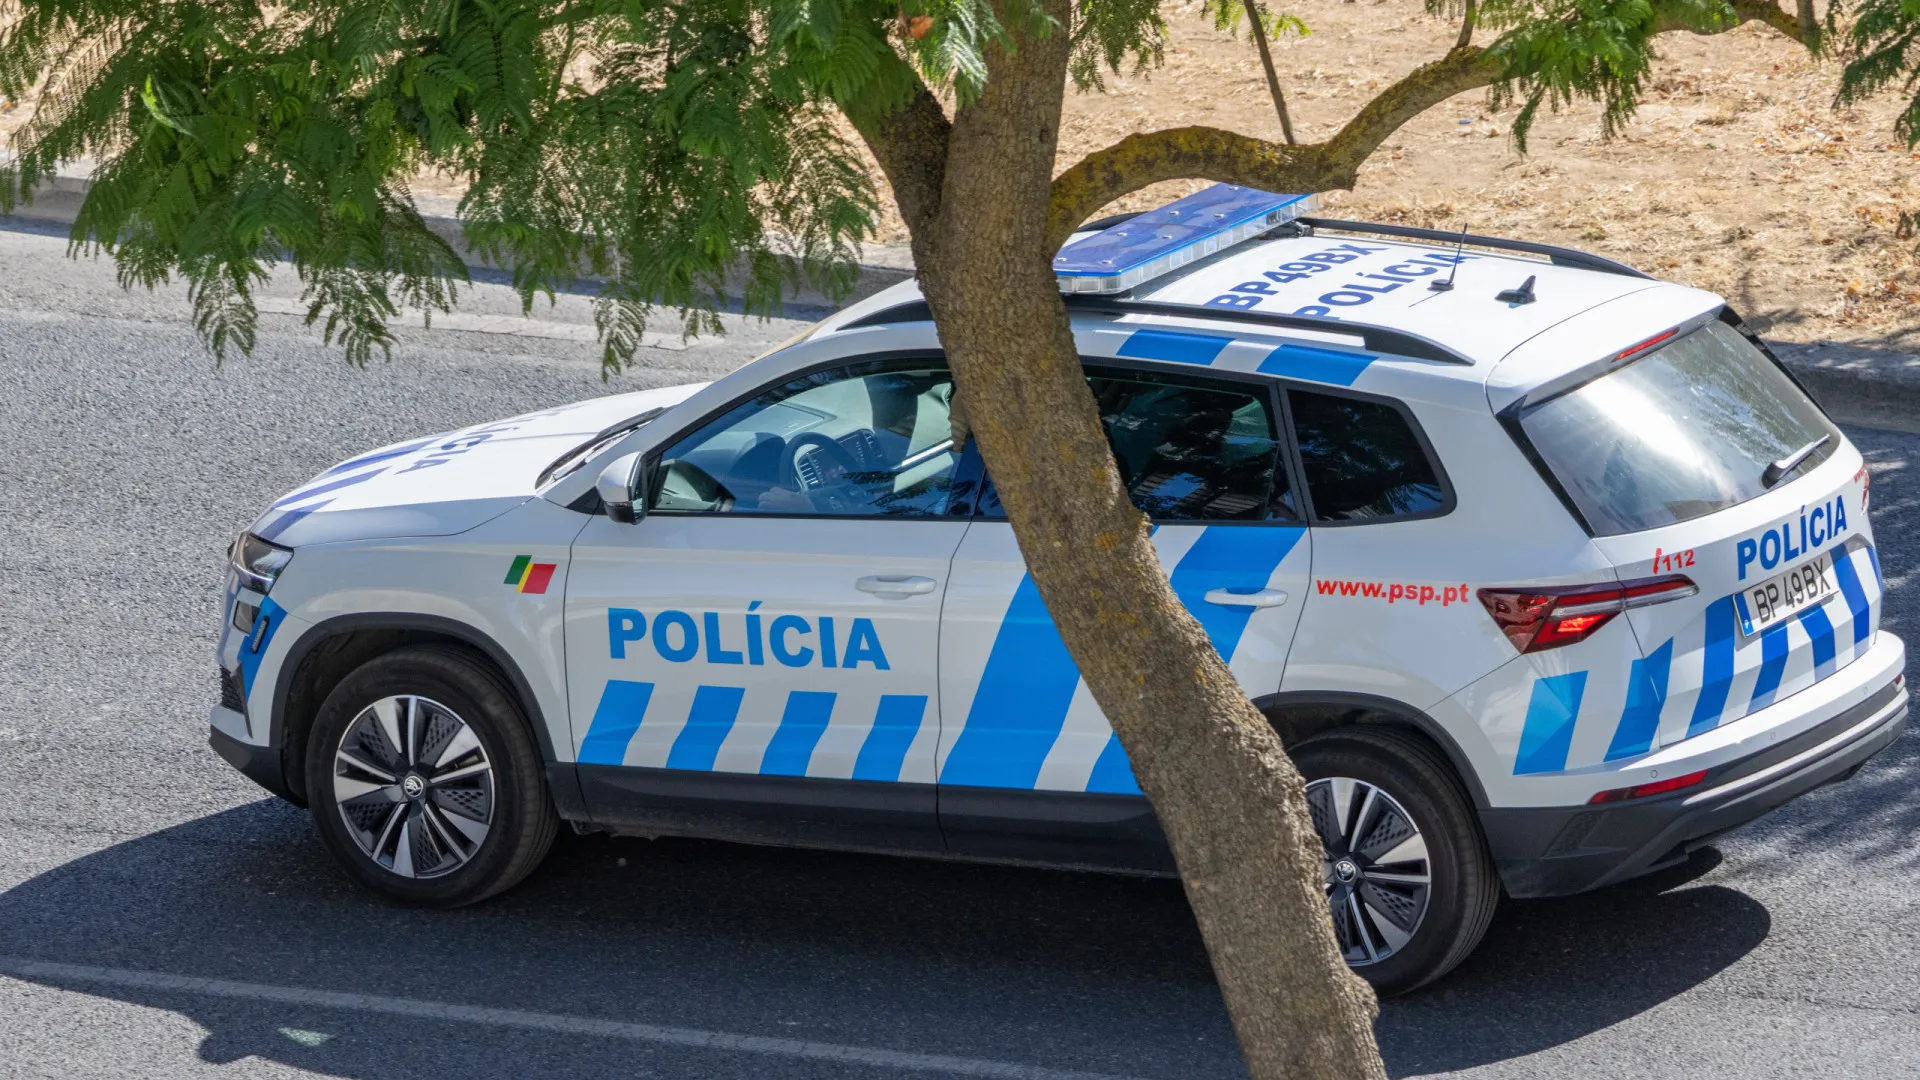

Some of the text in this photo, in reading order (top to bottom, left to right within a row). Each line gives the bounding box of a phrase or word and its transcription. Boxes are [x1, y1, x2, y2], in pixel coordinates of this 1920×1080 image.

[1202, 243, 1391, 311] BP49BX
[1292, 253, 1483, 320] POLÍCIA
[1662, 549, 1696, 572] 112
[1736, 495, 1848, 581] POLÍCIA
[1316, 579, 1469, 607] www.psp.pt
[1753, 583, 1780, 624] BP
[608, 600, 891, 671] POLÍCIA
